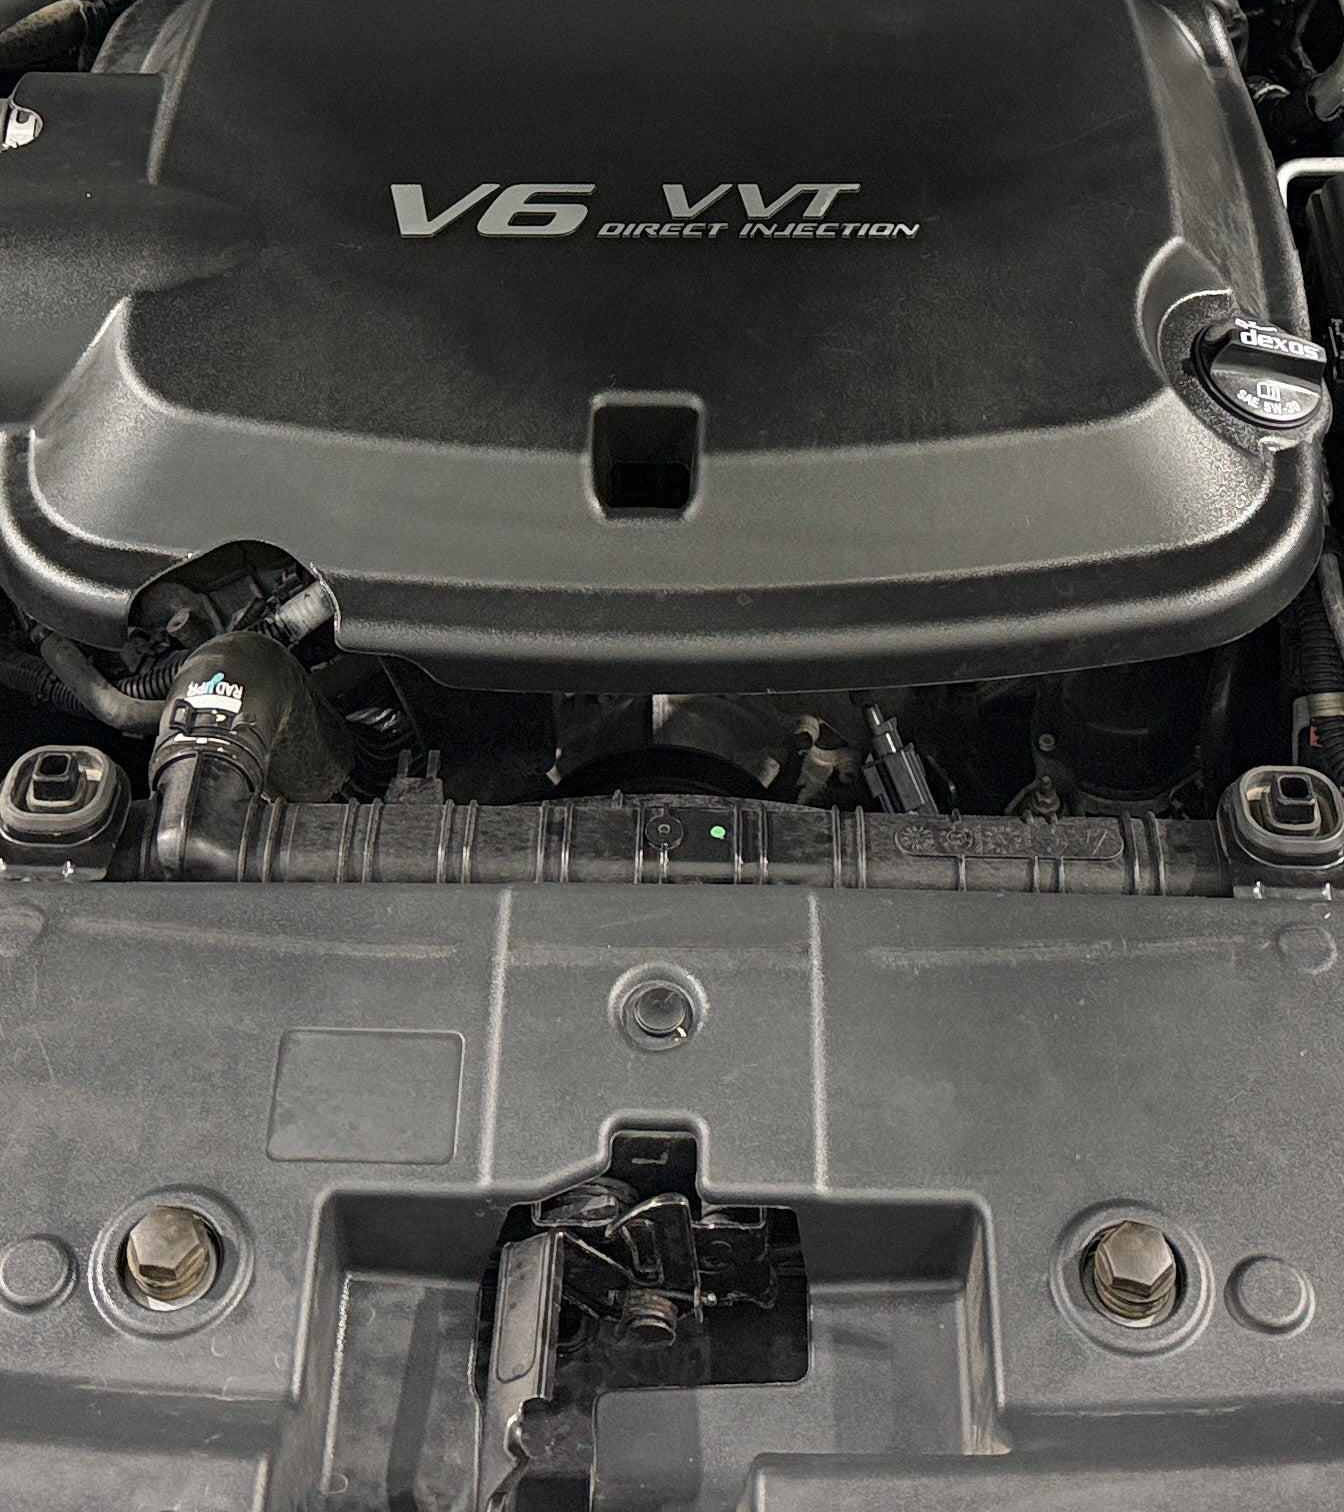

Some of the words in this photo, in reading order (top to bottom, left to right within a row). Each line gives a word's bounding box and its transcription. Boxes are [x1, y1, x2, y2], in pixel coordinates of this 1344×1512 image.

[390, 183, 596, 238] V6
[661, 183, 861, 220] VVT
[596, 222, 729, 239] DIRECT
[737, 222, 922, 239] INJECTION
[1240, 329, 1320, 361] dexos
[1237, 389, 1260, 409] SAE
[216, 681, 244, 700] RAD
